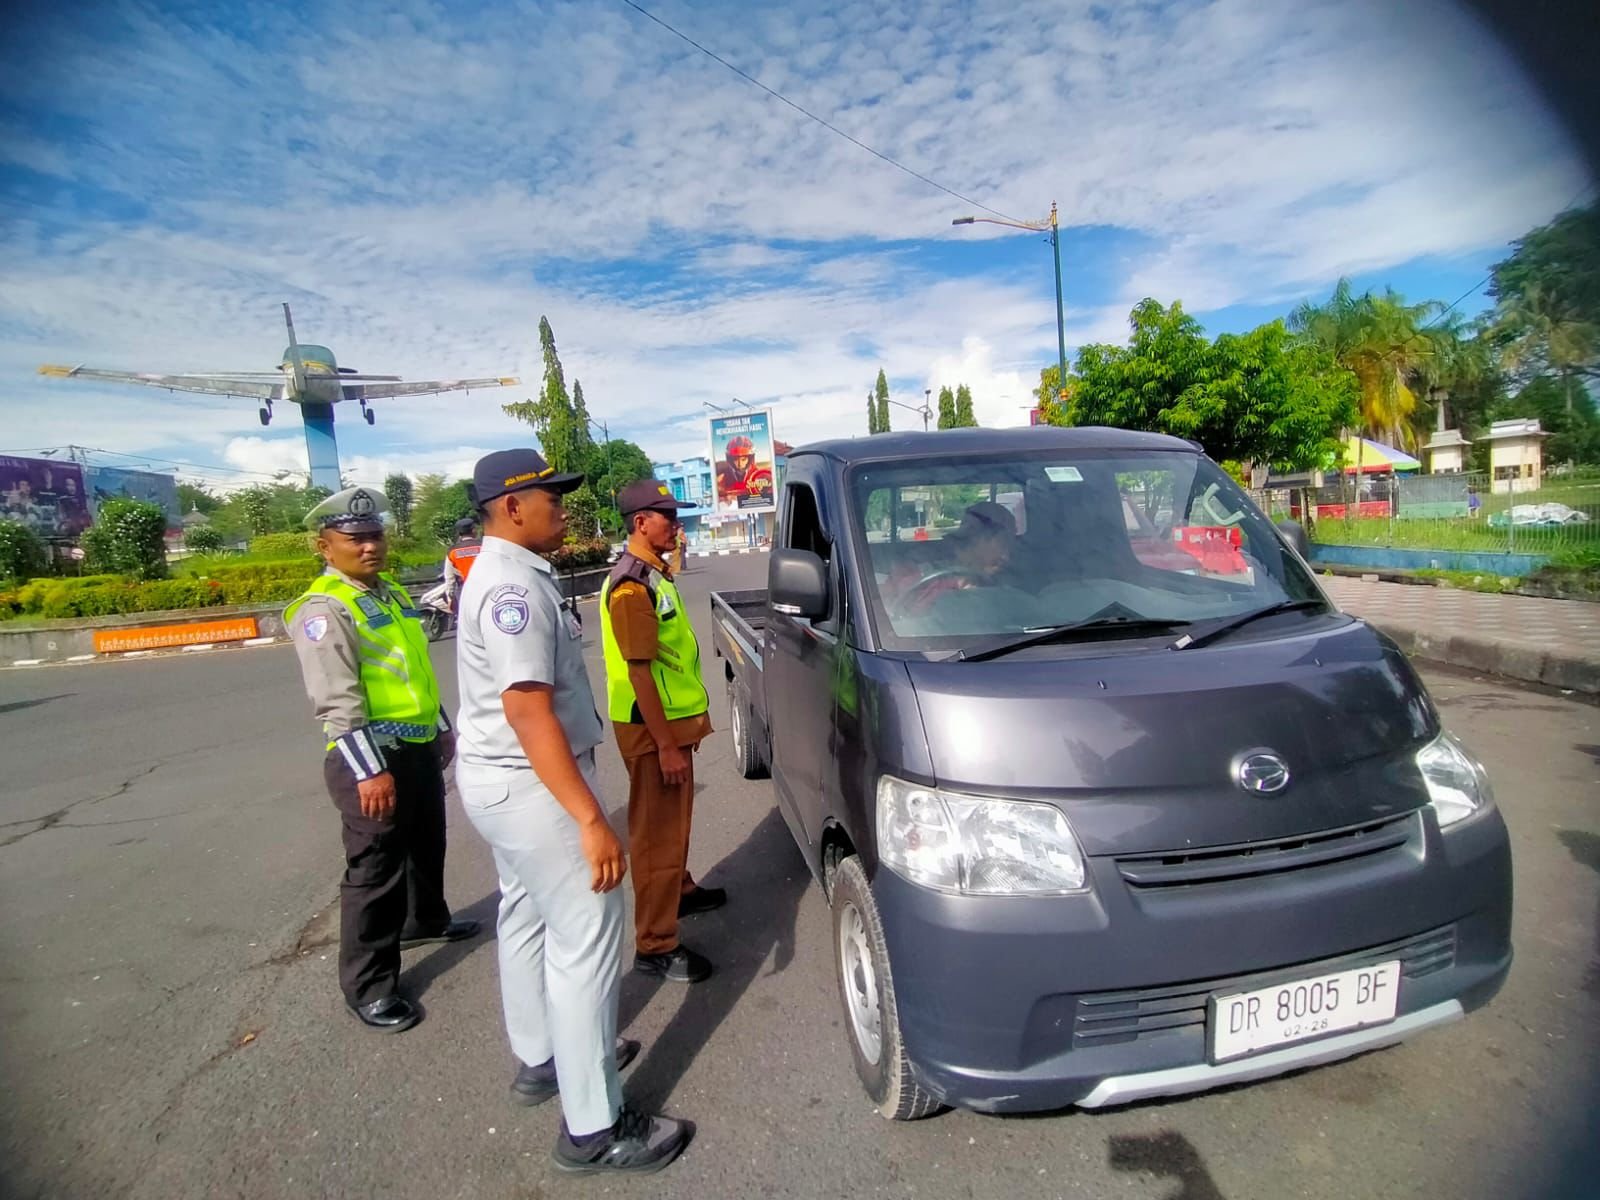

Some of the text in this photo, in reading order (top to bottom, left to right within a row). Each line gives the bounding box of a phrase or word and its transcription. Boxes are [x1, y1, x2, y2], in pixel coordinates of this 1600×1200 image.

[1230, 971, 1388, 1035] DR 8005 BF
